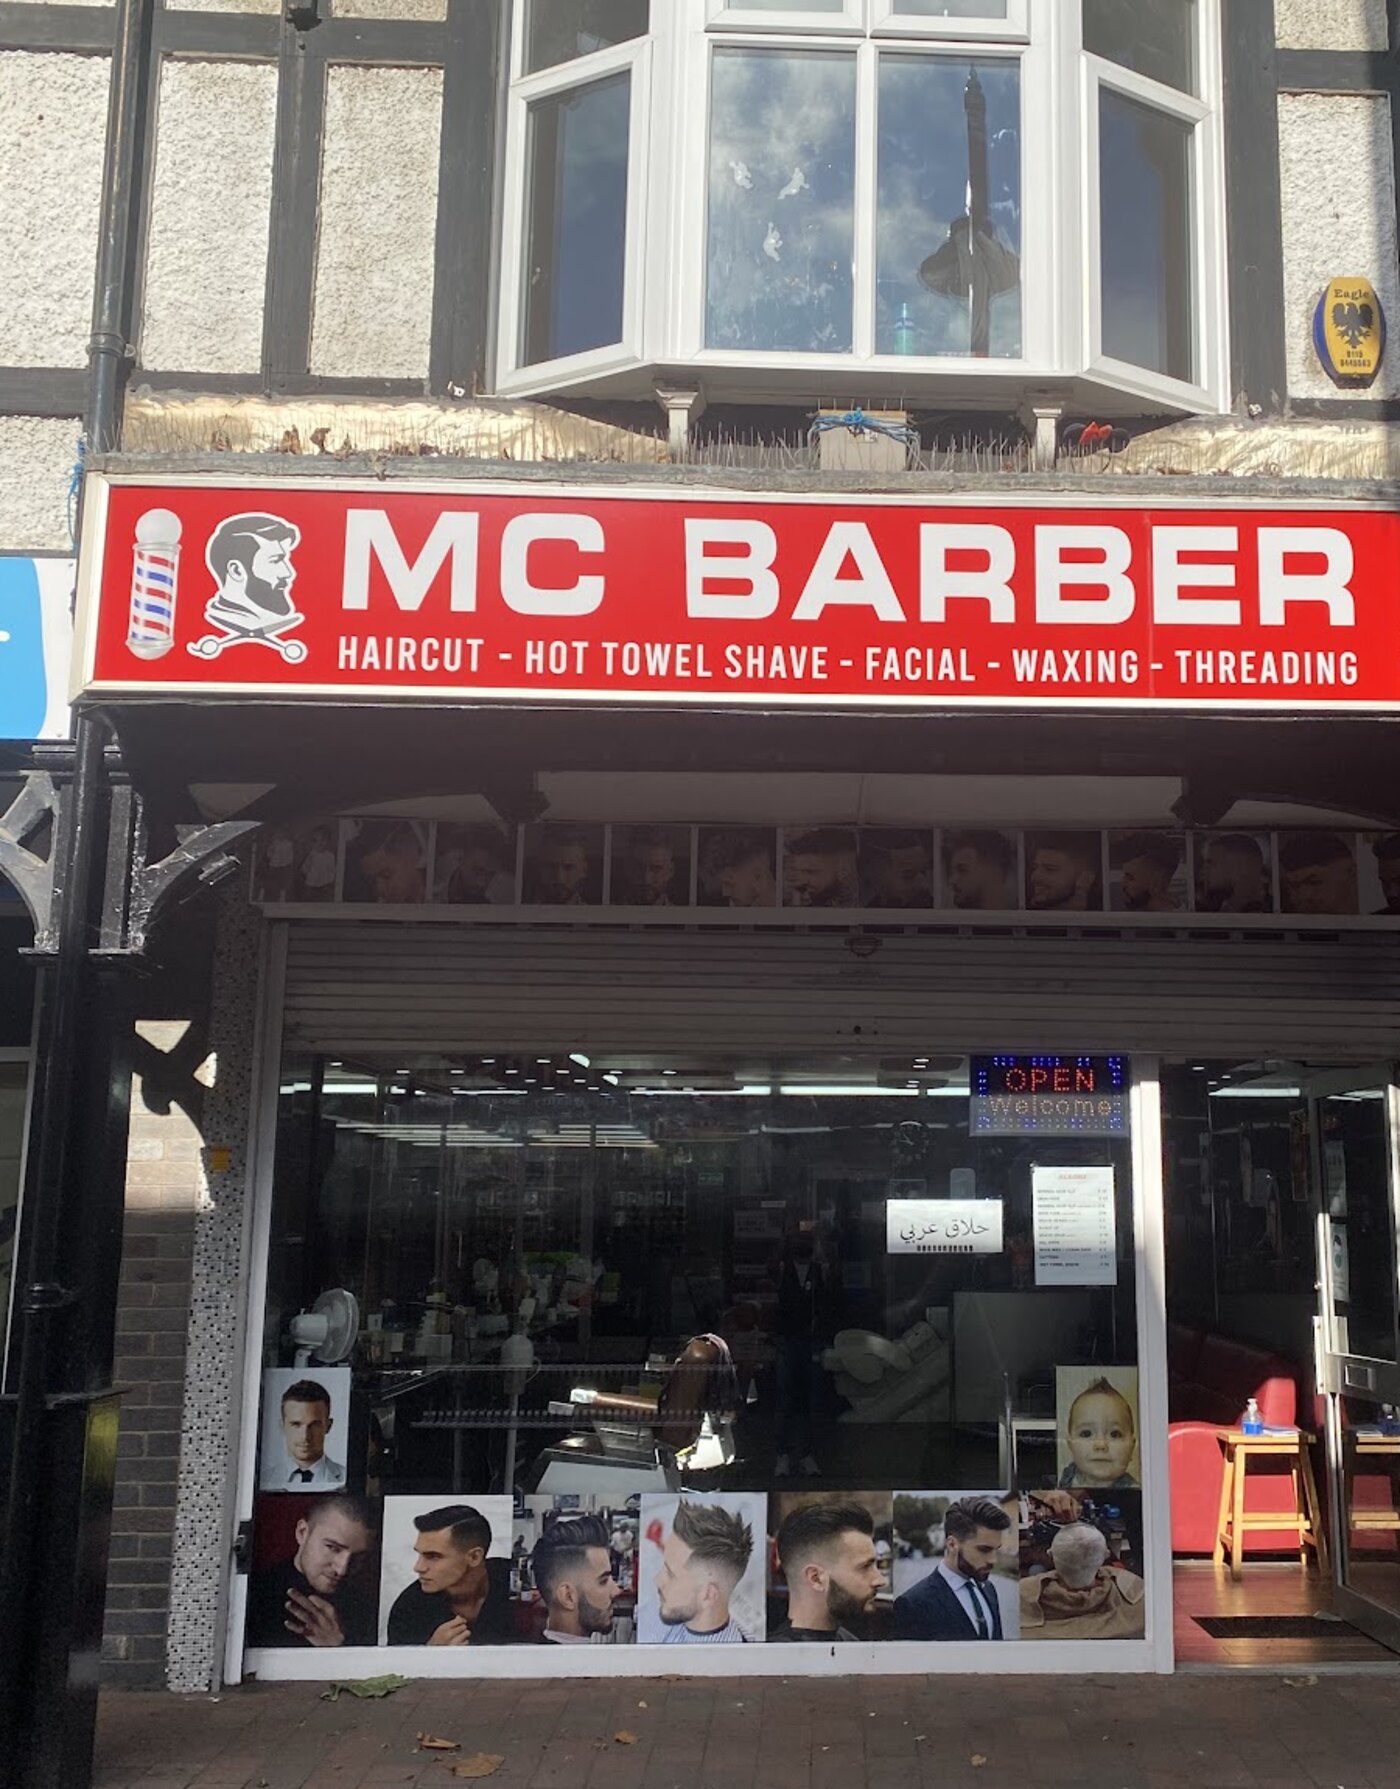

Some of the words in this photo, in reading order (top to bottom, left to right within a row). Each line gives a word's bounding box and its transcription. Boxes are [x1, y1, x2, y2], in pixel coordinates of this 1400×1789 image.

[1333, 288, 1370, 301] Eagle
[342, 509, 605, 617] MC
[684, 518, 1355, 626] BARBER
[338, 636, 484, 672] HAIRCUT
[525, 641, 589, 675] HOT
[602, 642, 712, 678] TOWEL
[725, 645, 828, 679] SHAVE
[866, 647, 976, 682] FACIAL
[1013, 650, 1138, 684] WAXING
[1175, 651, 1358, 685] THREADING
[1006, 1068, 1094, 1092] OPEN
[989, 1094, 1112, 1116] Welcome
[899, 1223, 939, 1244] عربي
[944, 1217, 990, 1238] حلاق
